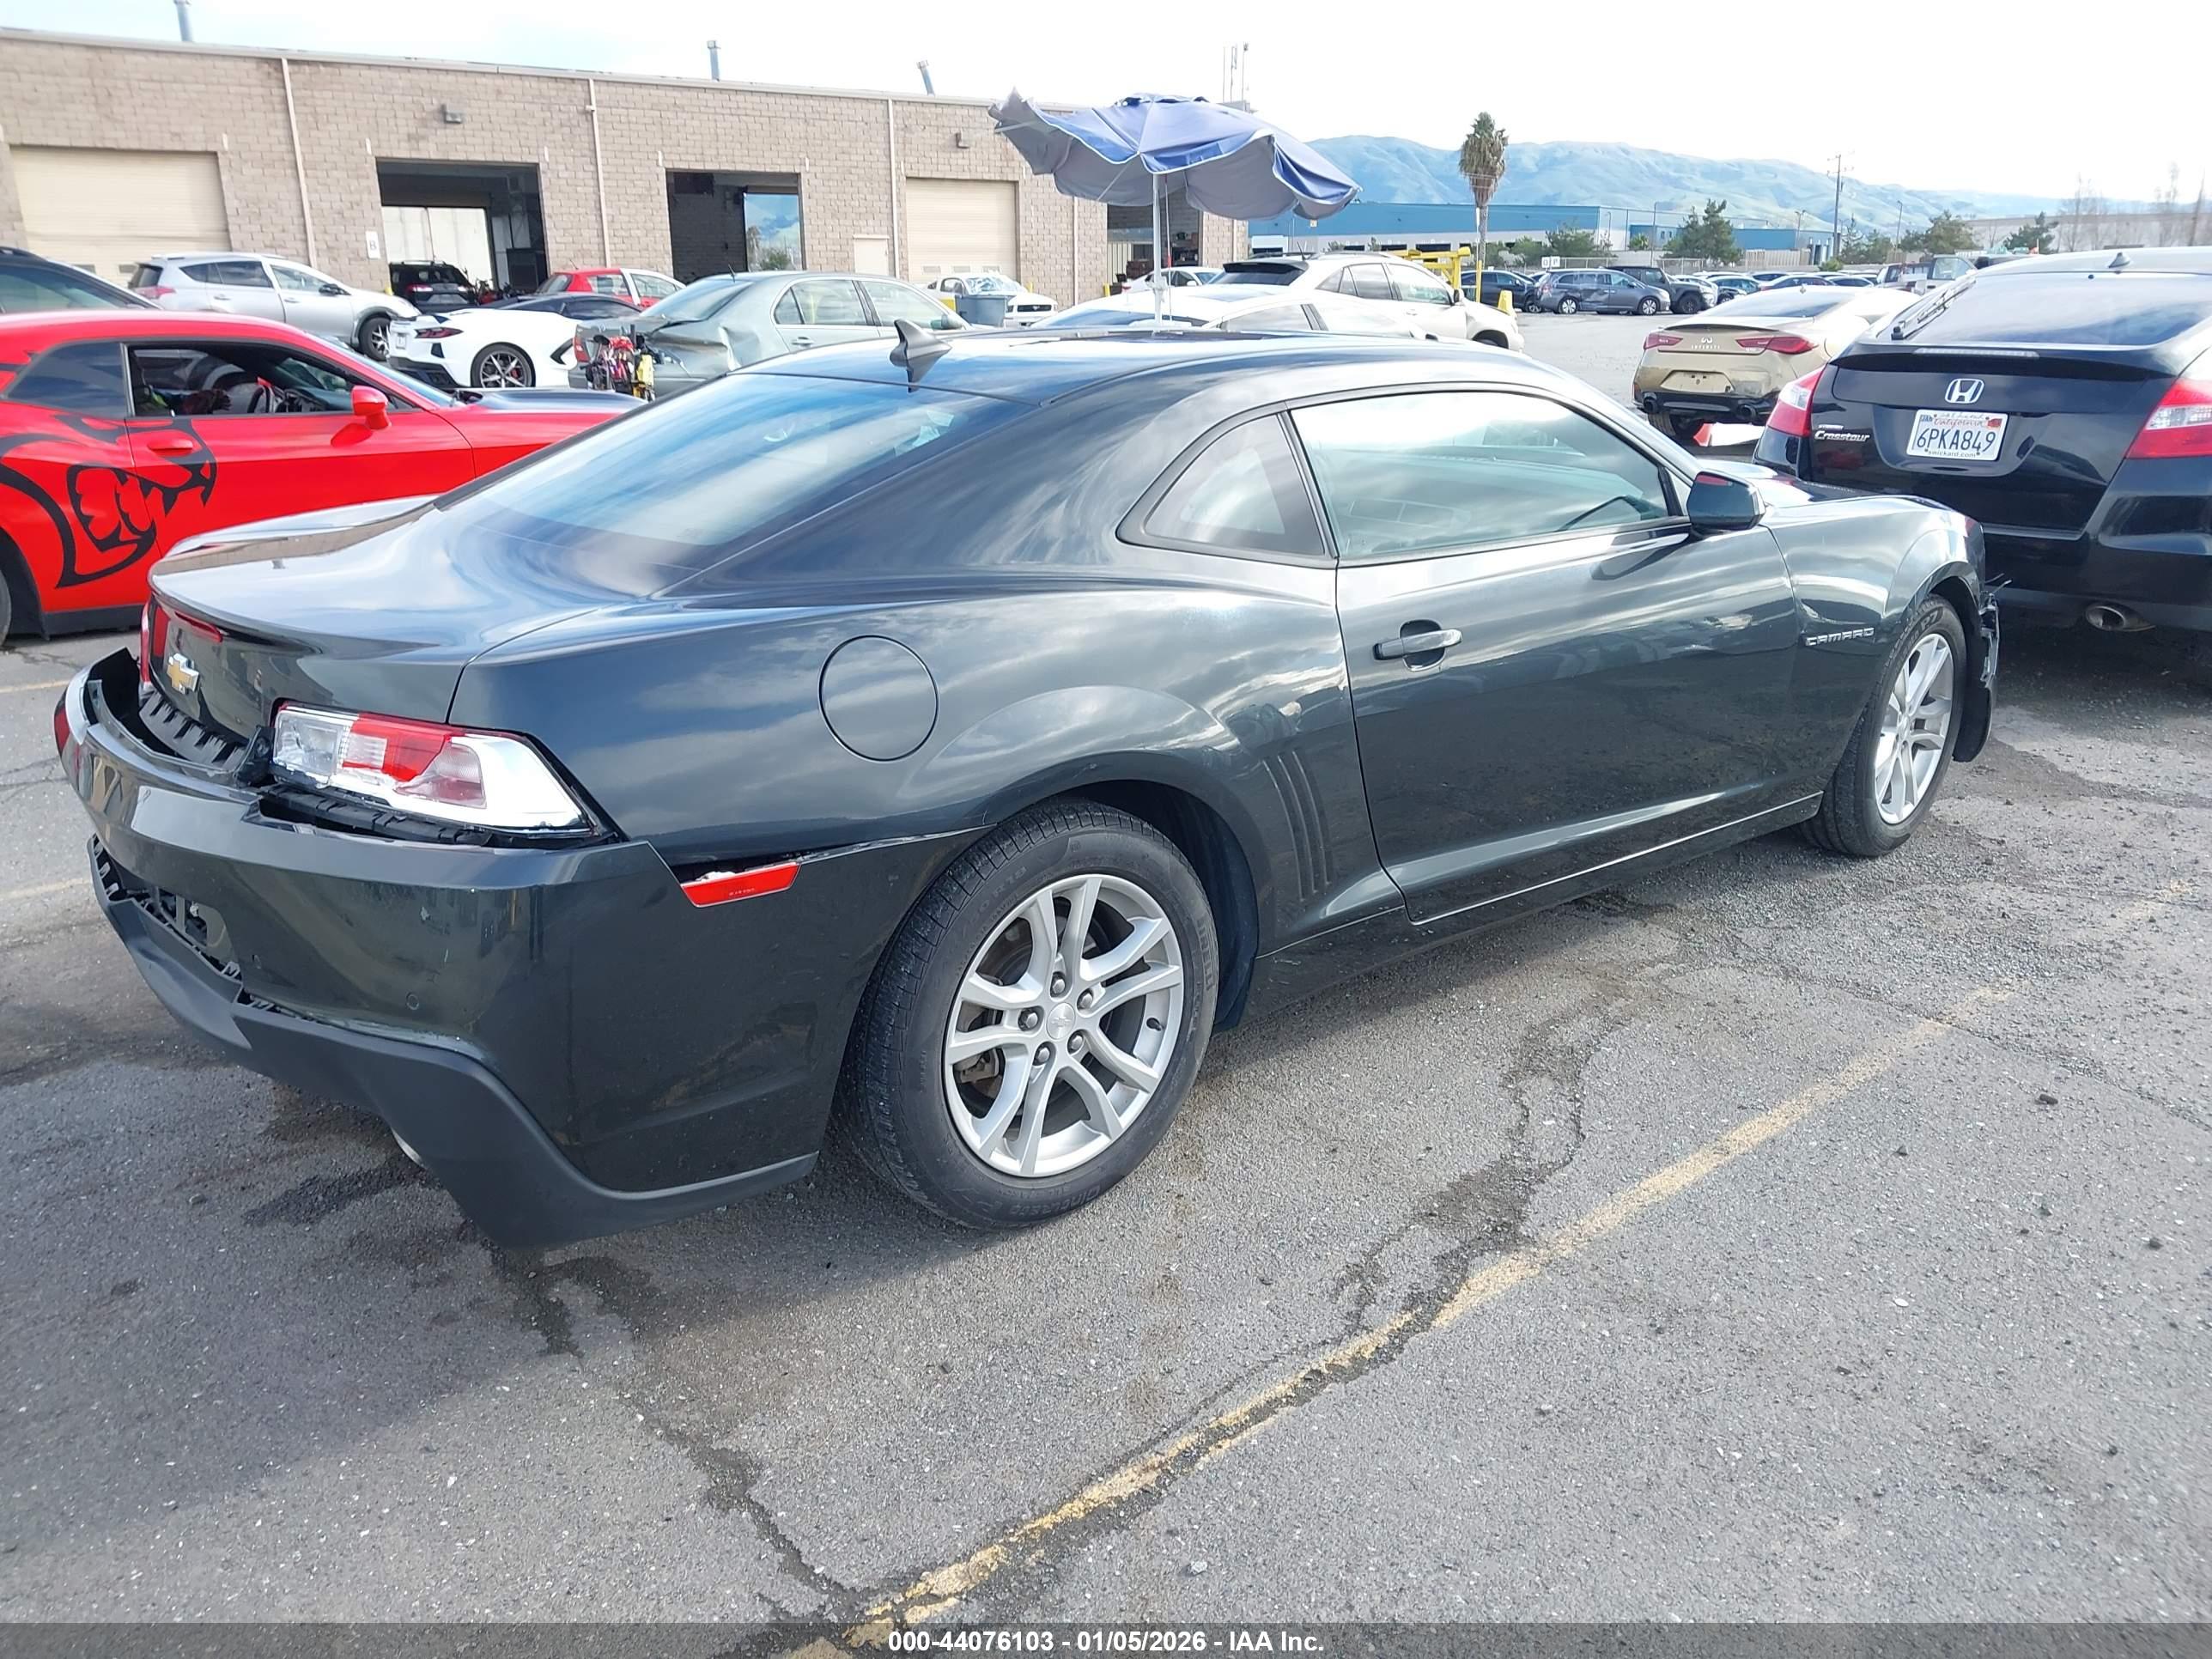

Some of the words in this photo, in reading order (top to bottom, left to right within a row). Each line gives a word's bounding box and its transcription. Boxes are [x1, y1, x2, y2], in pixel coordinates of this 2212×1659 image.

[1934, 418, 1984, 428] California
[1814, 430, 1870, 442] Crosstour
[1917, 428, 1996, 453] 6PKA849
